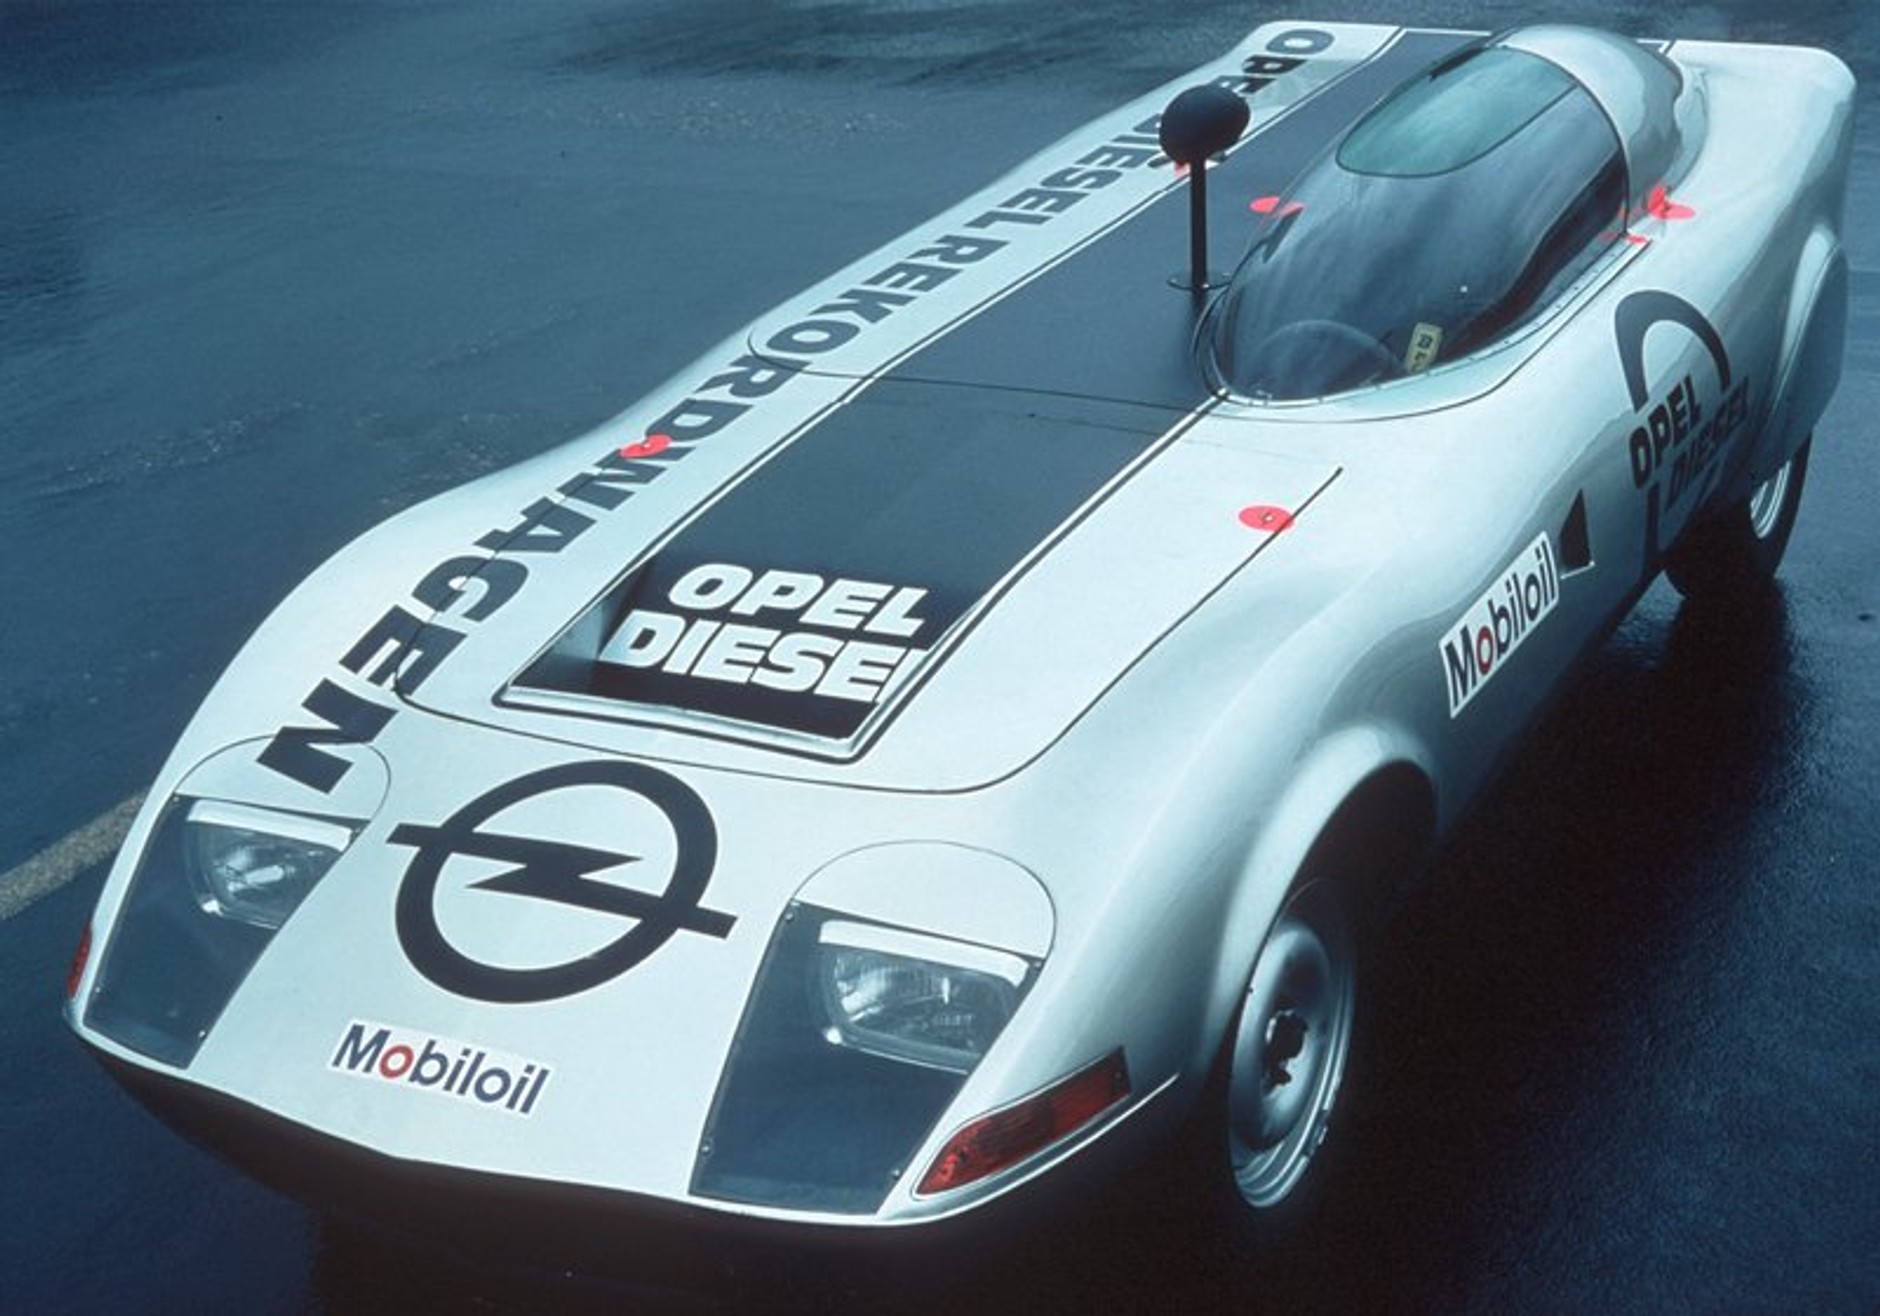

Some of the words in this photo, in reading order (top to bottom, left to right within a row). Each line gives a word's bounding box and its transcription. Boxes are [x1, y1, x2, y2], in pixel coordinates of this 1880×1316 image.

[1211, 28, 1336, 95] OPE
[1629, 373, 1701, 491] OPEL
[668, 563, 928, 638] OPEL
[1444, 539, 1557, 708] Mobiloil
[331, 1023, 551, 1115] Mobiloil
